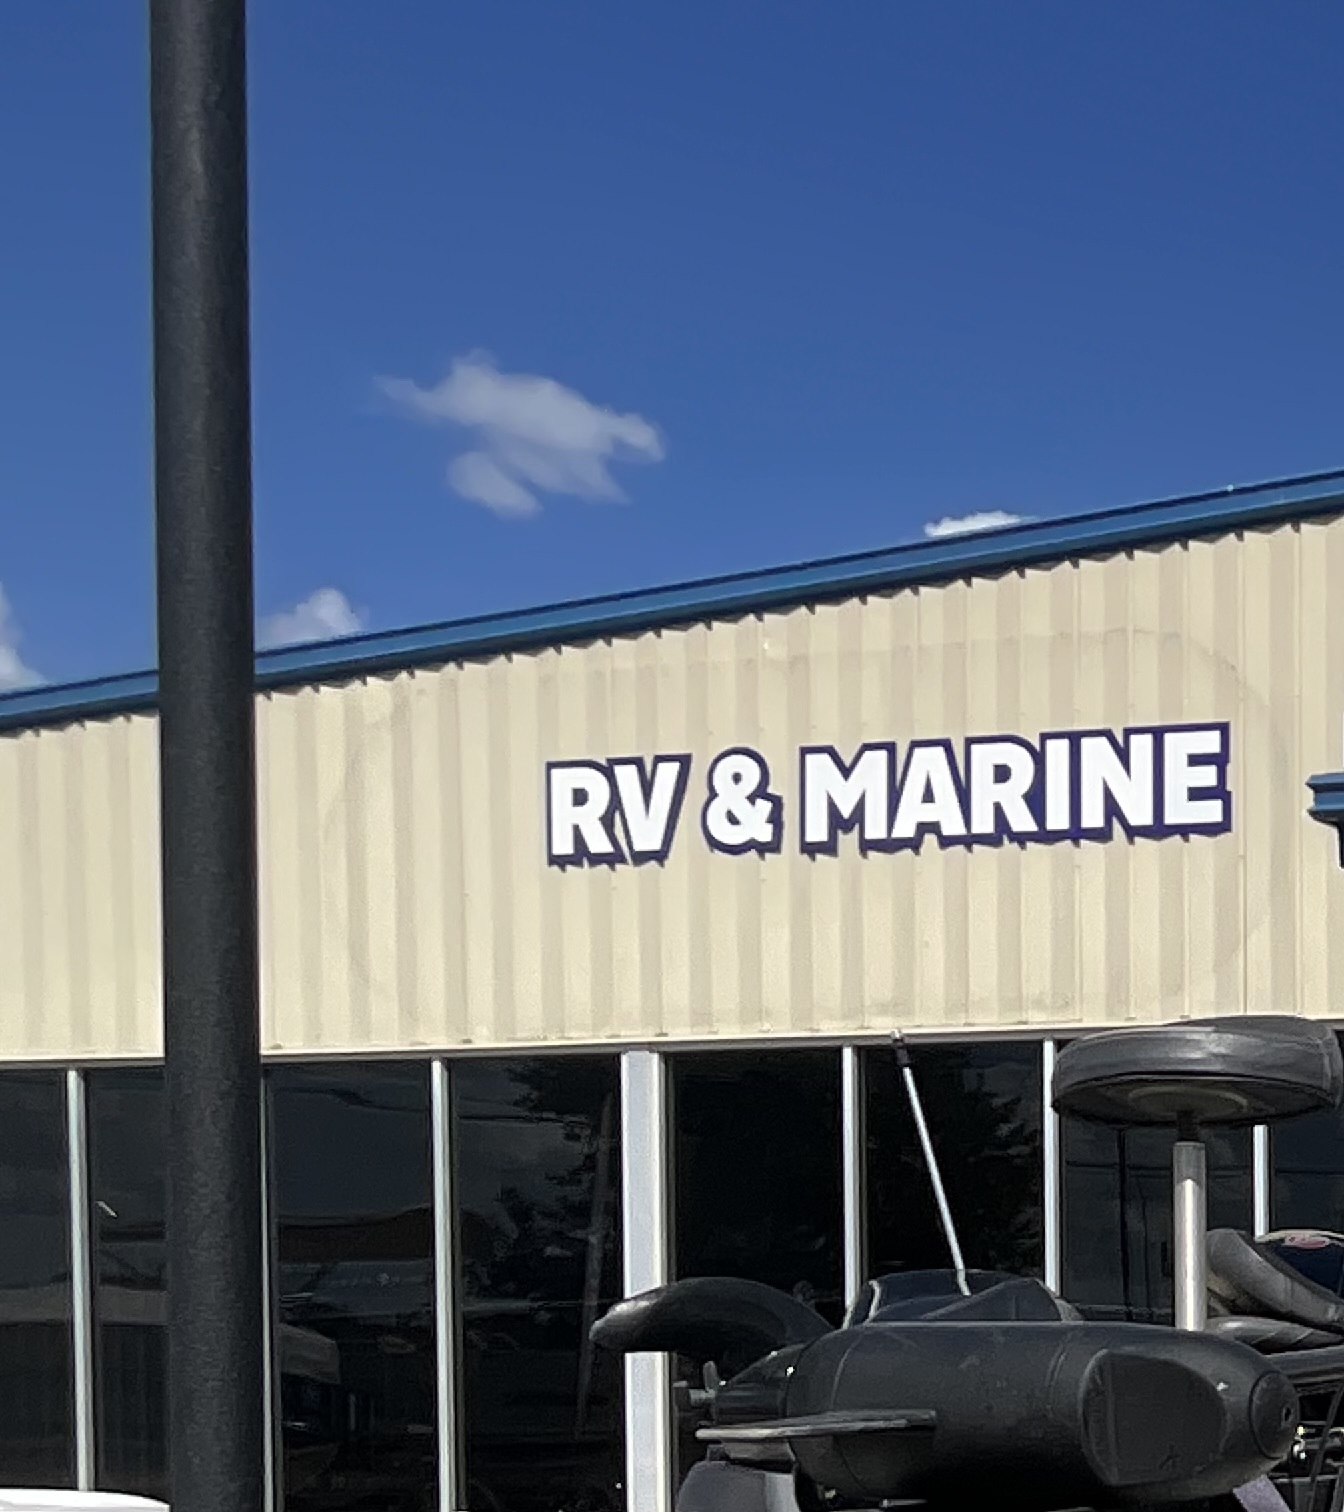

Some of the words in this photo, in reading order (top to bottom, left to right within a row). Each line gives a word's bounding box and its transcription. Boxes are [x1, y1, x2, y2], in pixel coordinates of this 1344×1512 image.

[549, 760, 683, 857] RV
[704, 753, 775, 846] &
[803, 729, 1224, 843] MARINE
